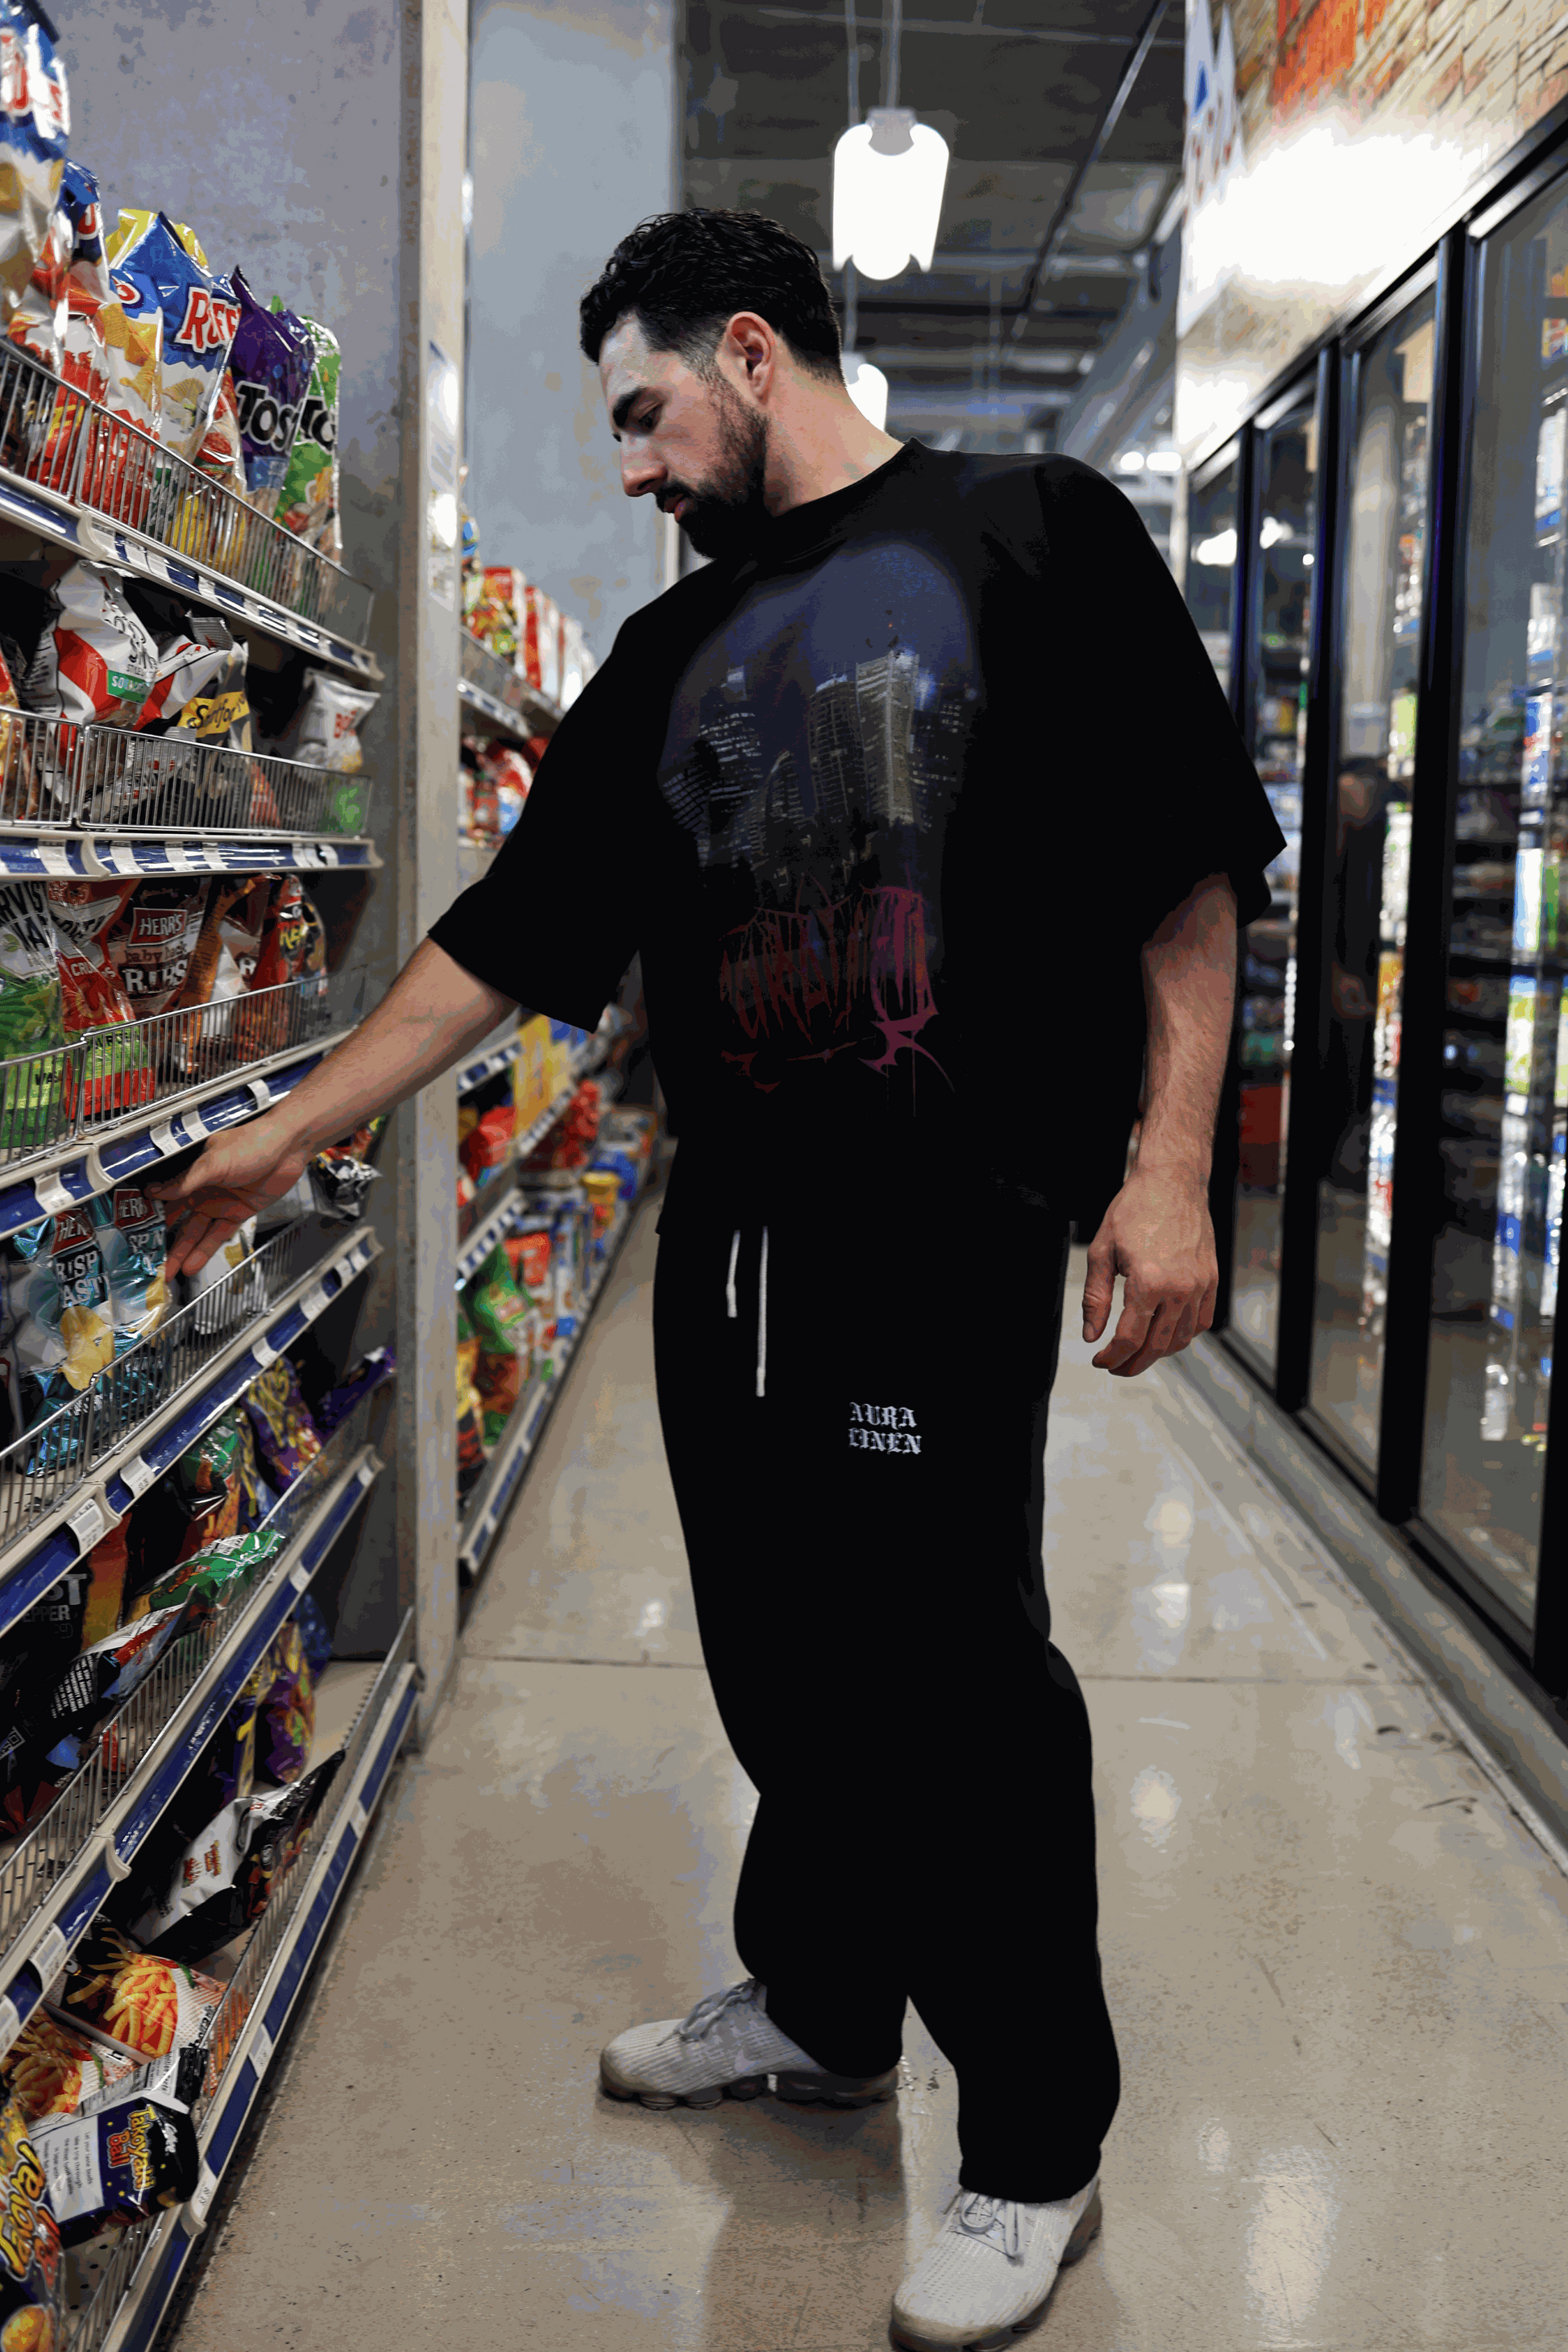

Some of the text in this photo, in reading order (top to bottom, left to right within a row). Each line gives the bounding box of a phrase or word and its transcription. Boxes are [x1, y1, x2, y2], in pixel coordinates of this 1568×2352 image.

[139, 914, 183, 937] HERR'S
[849, 1402, 917, 1430] AURA
[108, 2129, 131, 2167] Ball
[128, 2104, 157, 2190] Takoyaki
